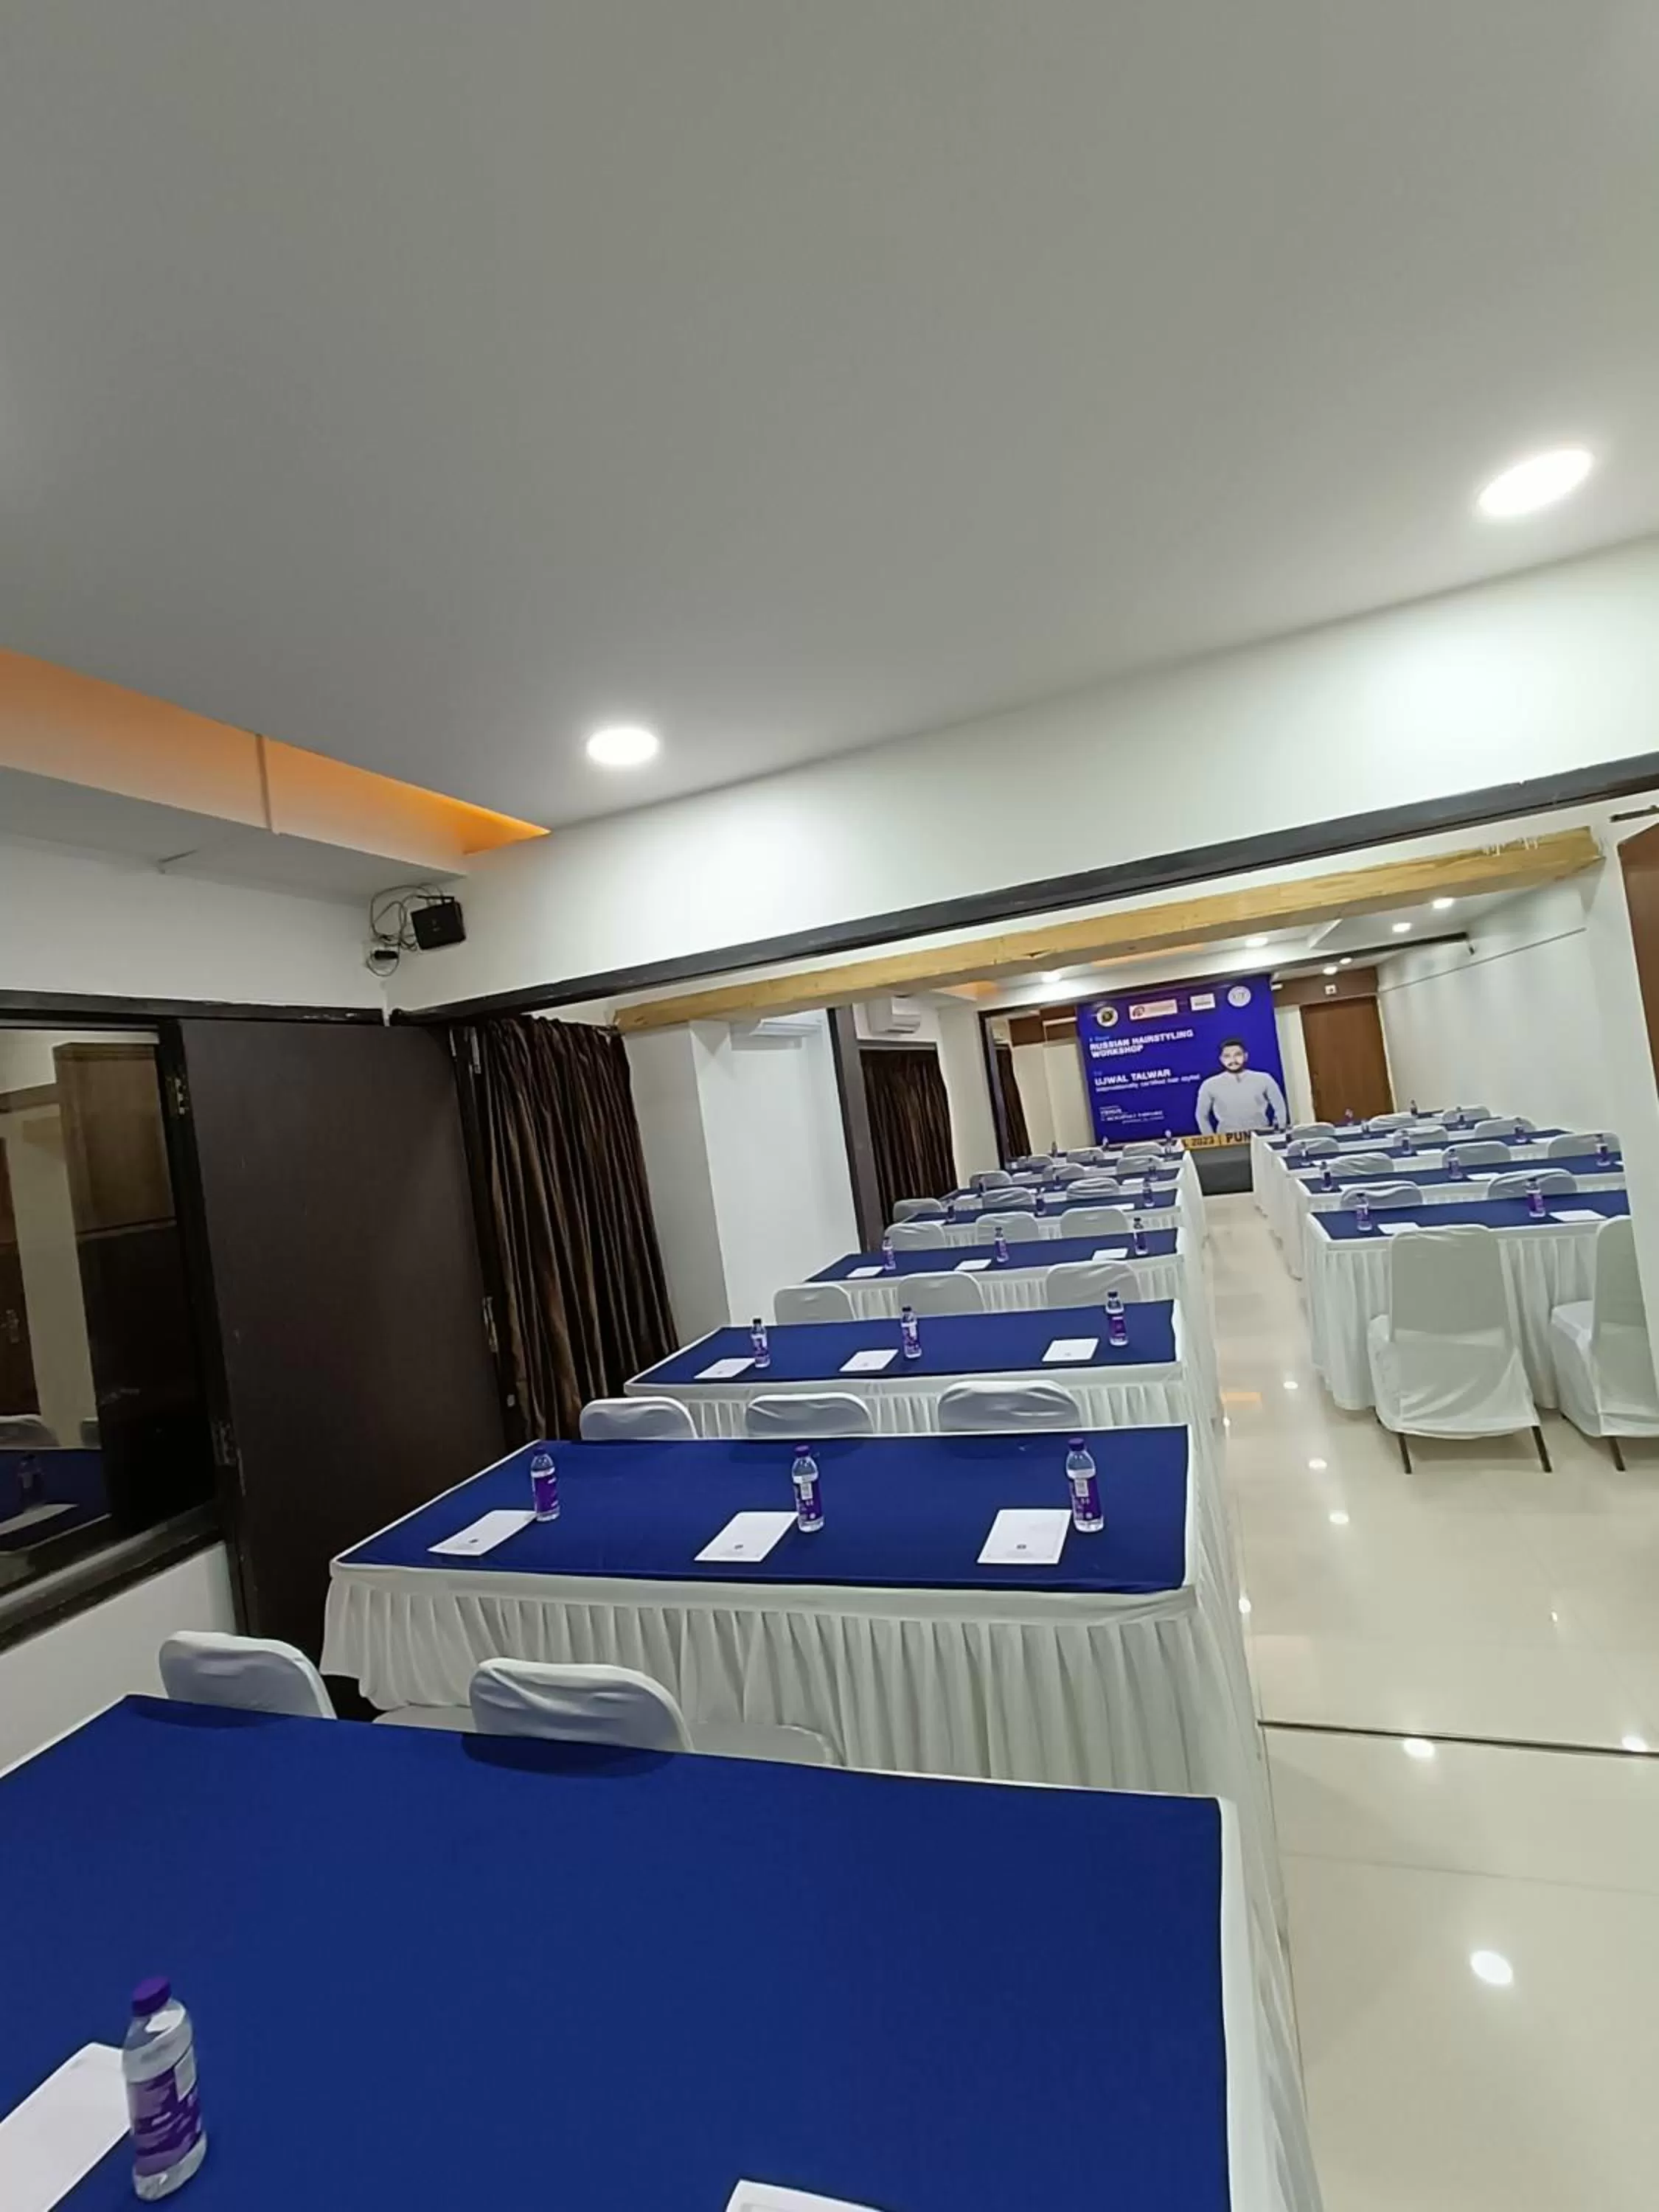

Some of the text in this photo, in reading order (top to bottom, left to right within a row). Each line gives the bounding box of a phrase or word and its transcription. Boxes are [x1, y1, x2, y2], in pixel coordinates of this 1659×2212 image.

[1090, 1038, 1130, 1051] RUSSIAN
[1132, 1029, 1194, 1044] HAIRSTYLING
[1091, 1044, 1144, 1058] WORKSHOP
[1094, 1068, 1172, 1086] UJWAL TALWAR
[1192, 1135, 1214, 1147] 2023
[1225, 1130, 1251, 1144] PUN
